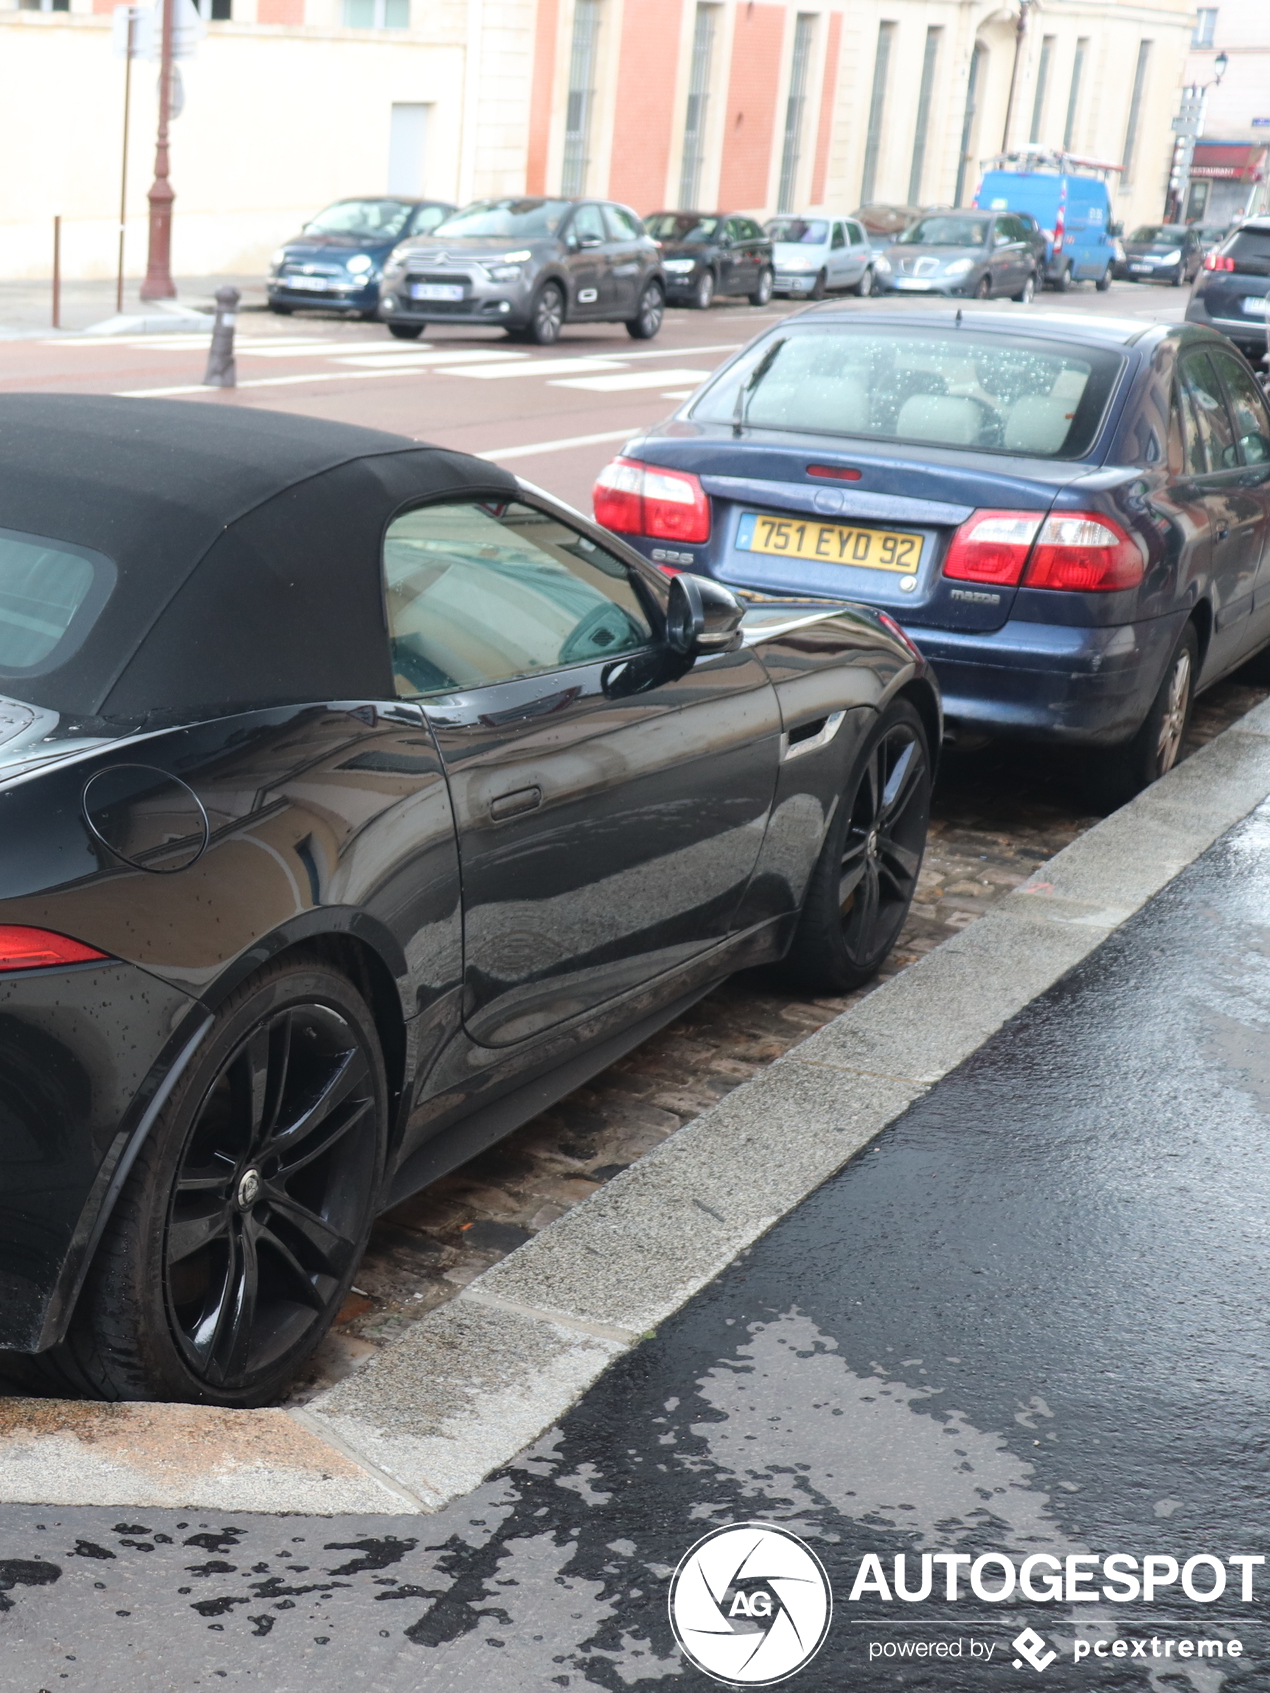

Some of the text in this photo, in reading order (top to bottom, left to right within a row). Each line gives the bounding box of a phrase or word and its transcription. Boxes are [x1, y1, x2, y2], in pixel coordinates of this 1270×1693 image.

[761, 520, 807, 552] 751
[815, 528, 872, 560] EYD
[880, 536, 916, 567] 92
